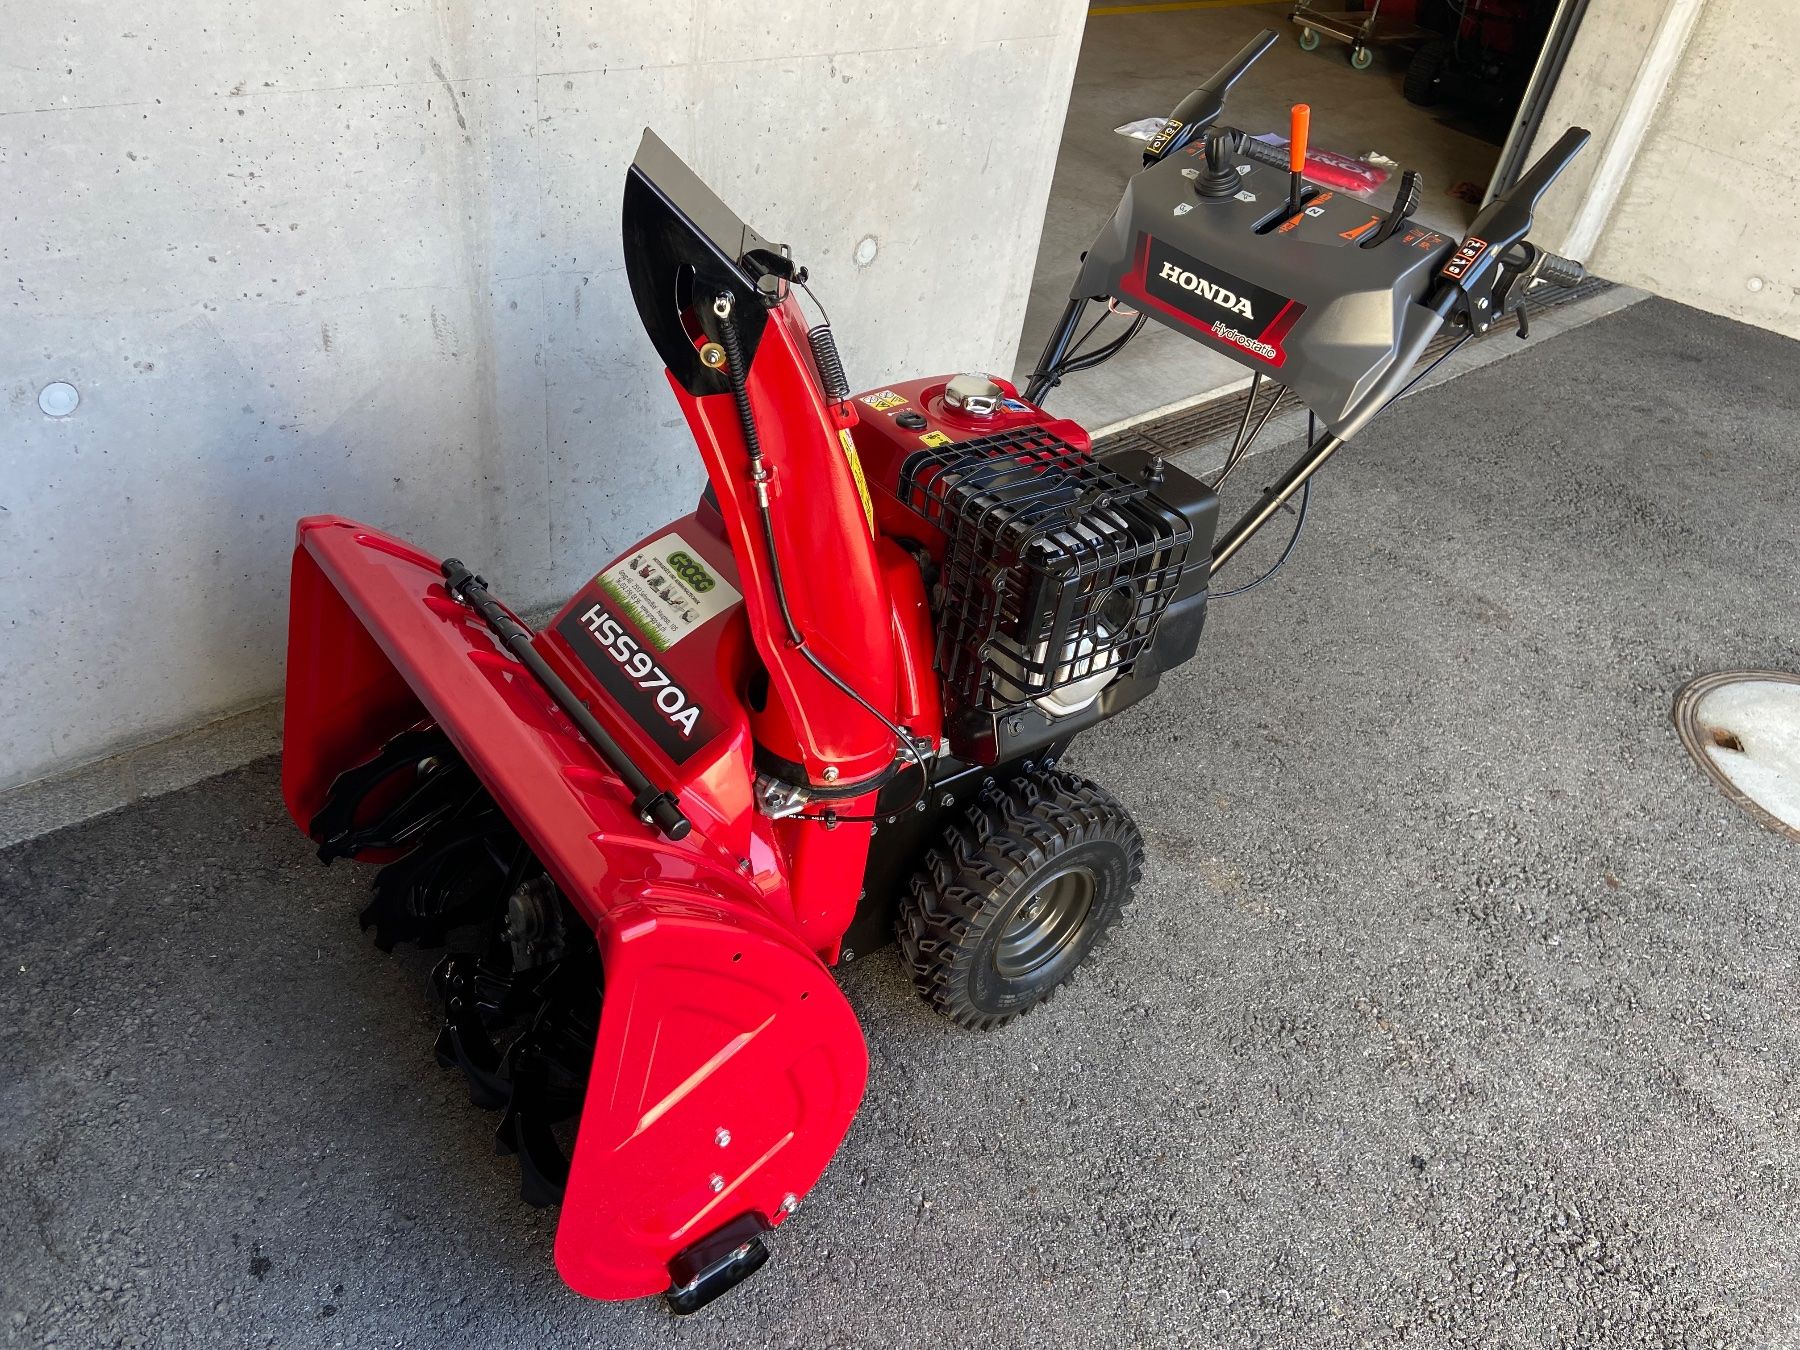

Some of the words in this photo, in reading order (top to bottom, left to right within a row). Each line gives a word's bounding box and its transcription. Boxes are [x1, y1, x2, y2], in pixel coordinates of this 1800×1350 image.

[1159, 261, 1254, 320] HONDA
[1211, 320, 1277, 360] Hydrostatic
[669, 552, 714, 592] GROGG
[580, 603, 701, 737] HSS970A
